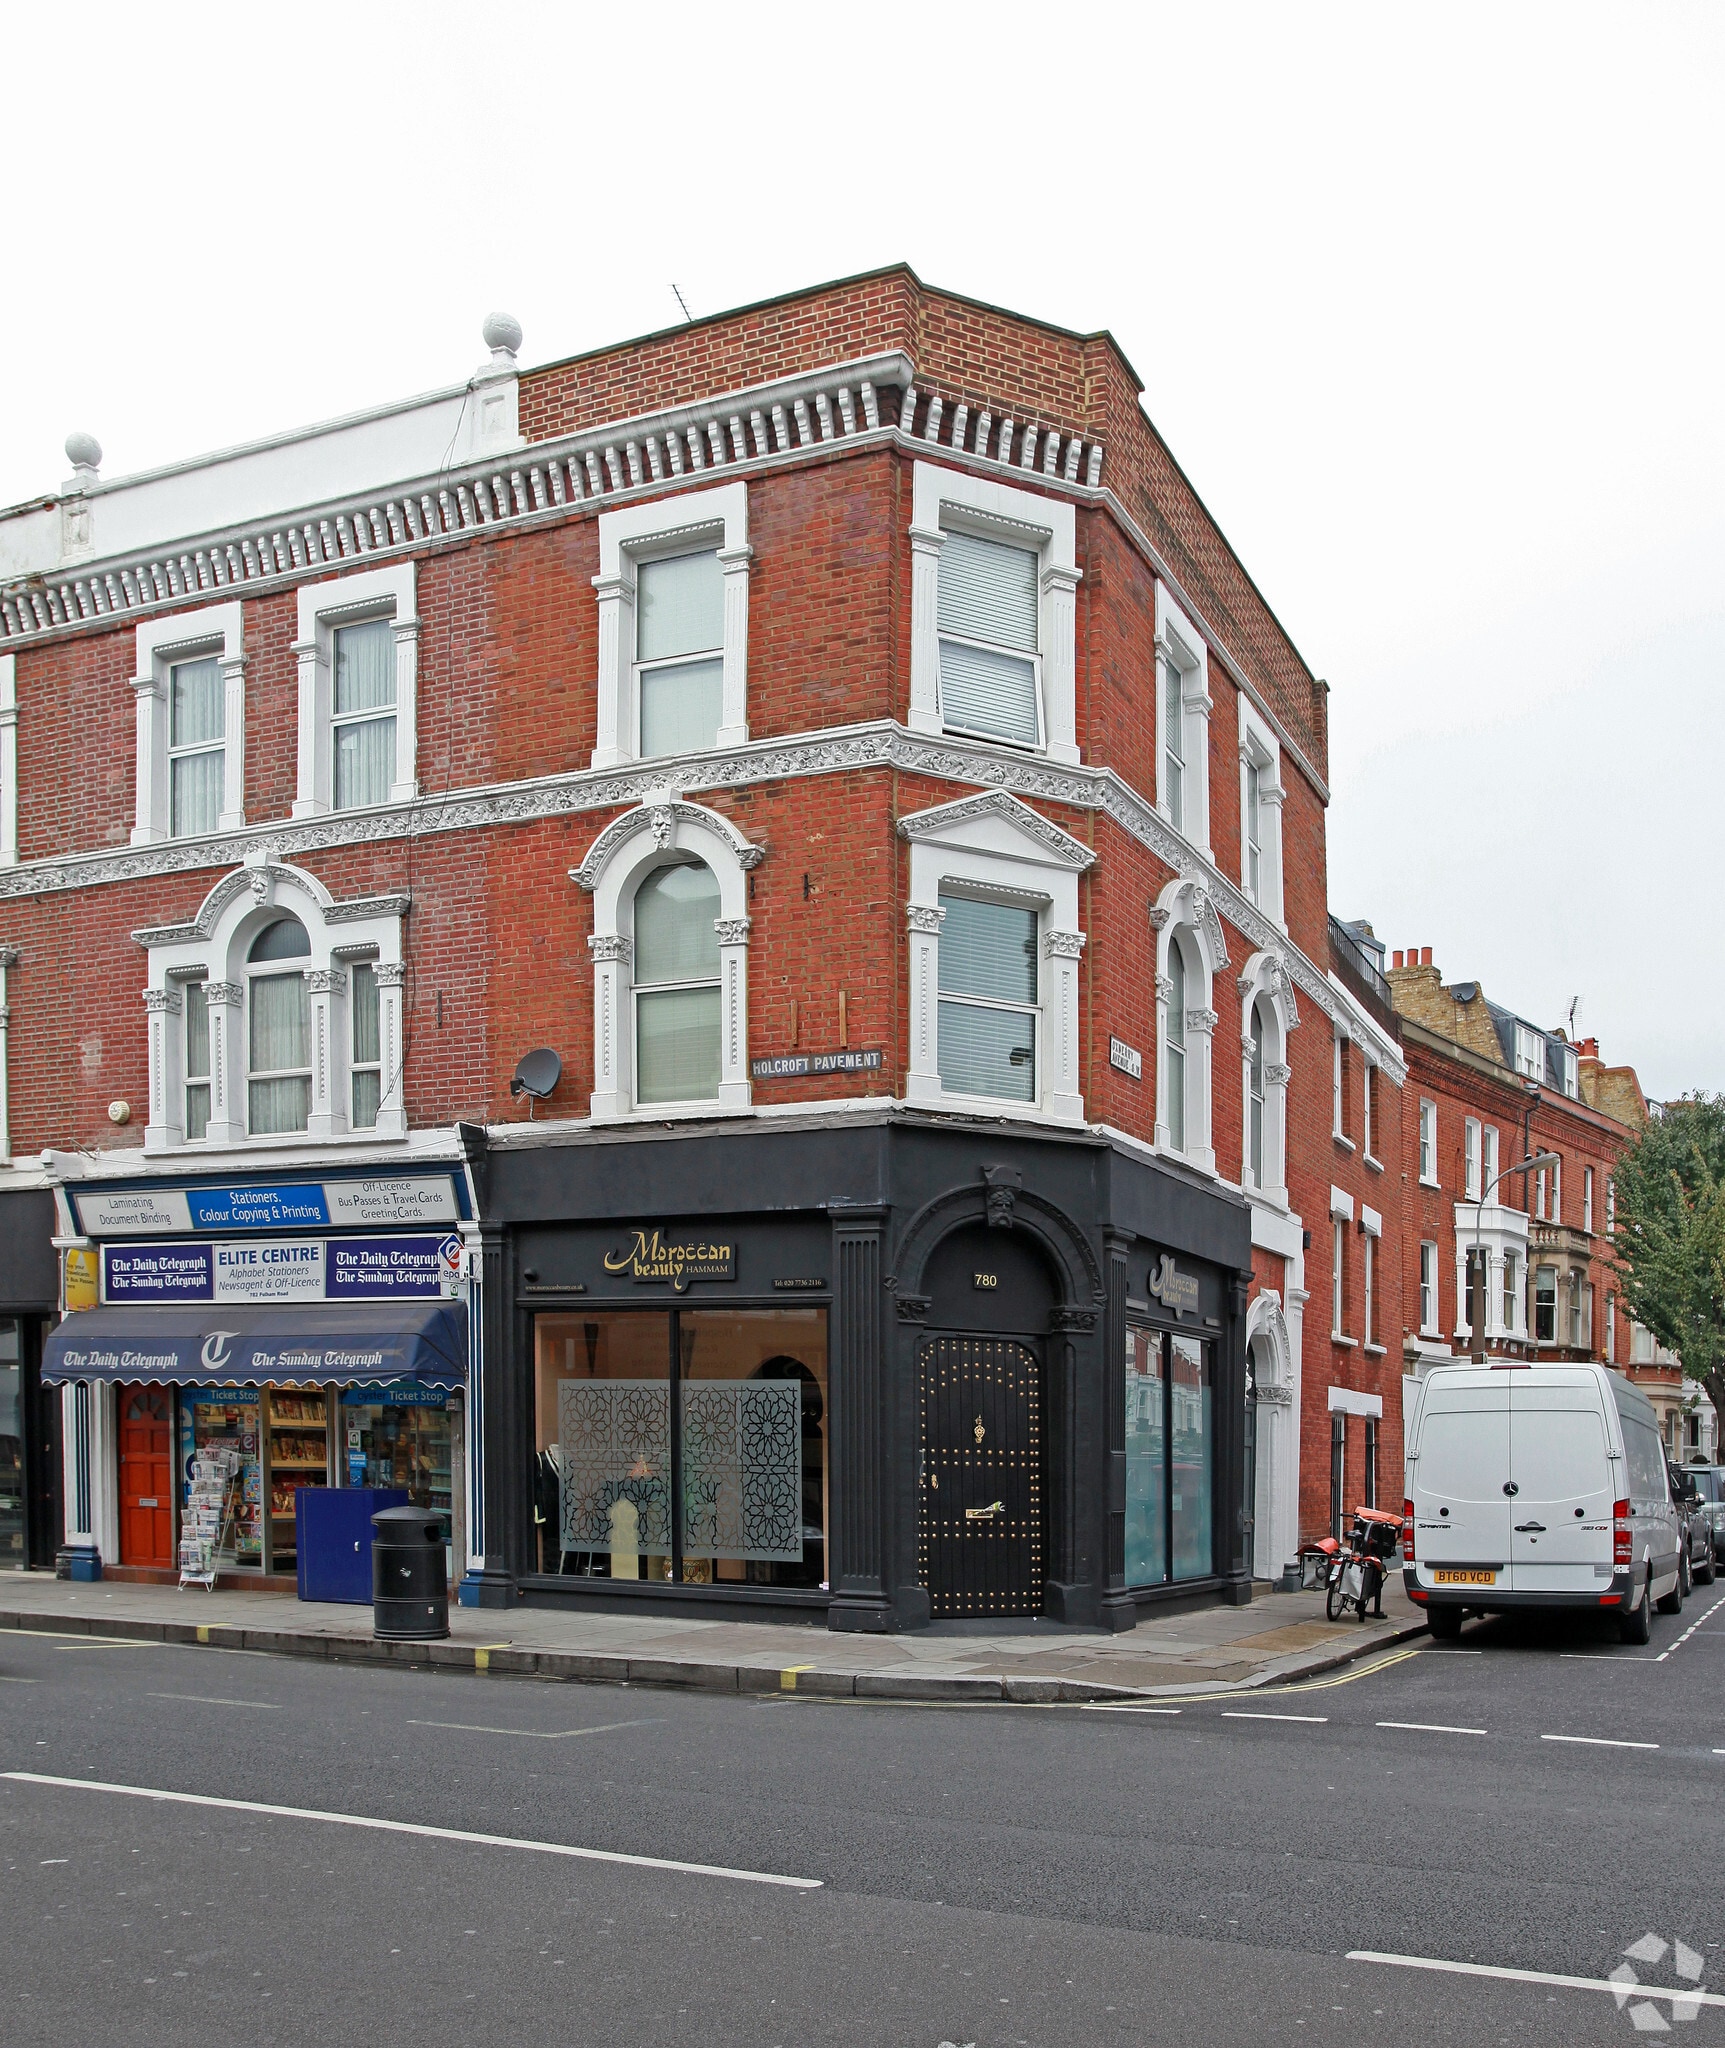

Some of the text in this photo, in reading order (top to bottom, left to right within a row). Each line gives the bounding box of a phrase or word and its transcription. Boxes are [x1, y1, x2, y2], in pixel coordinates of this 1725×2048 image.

[753, 1053, 879, 1075] HOLCROFT PAVEMENT
[362, 1181, 411, 1192] Off-Licence
[108, 1198, 154, 1210] Laminating
[229, 1191, 281, 1205] Stationers.
[338, 1191, 443, 1207] Bus Passes & Travel Cards
[99, 1212, 171, 1225] Document Binding
[199, 1204, 322, 1223] Colour Copying & Printing
[219, 1247, 319, 1266] ELITE CENTRE
[604, 1231, 730, 1270] Moroccan
[112, 1256, 207, 1273] The Daily Telegraph
[336, 1251, 358, 1266] The
[359, 1251, 388, 1267] Daily
[229, 1266, 309, 1280] Alphabet Stationers
[336, 1270, 356, 1283] The
[357, 1270, 394, 1286] Sunday
[633, 1257, 728, 1290] beauty HAMMAM
[975, 1274, 997, 1287] 780
[112, 1274, 207, 1289] The Sunday Telegraph
[218, 1278, 320, 1292] Newsagent & Off-Licence
[64, 1351, 177, 1370] The Daily Telegraph
[252, 1351, 382, 1368] The Sunday Telegraph
[210, 1389, 237, 1401] Ticket
[239, 1390, 259, 1403] Stop
[358, 1390, 443, 1403] oyster Ticket Stop
[1438, 1570, 1491, 1583] BT60 VCD
